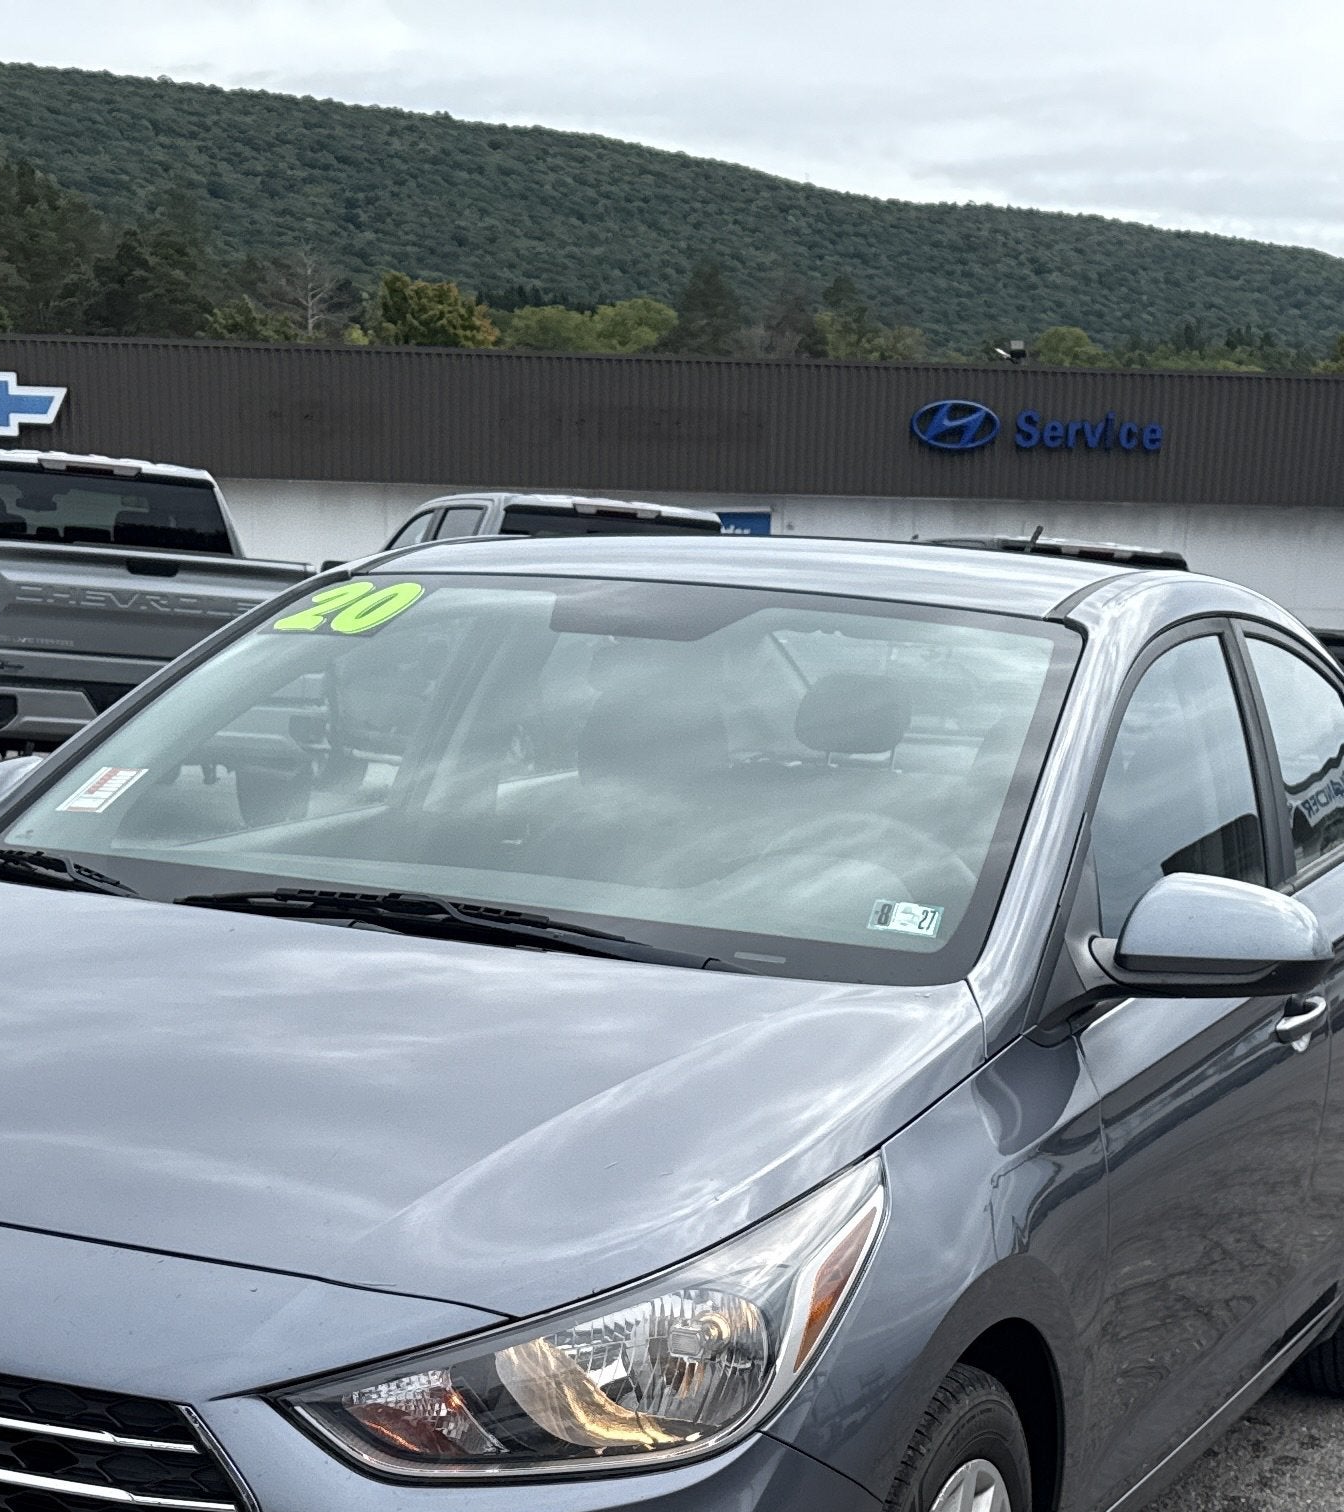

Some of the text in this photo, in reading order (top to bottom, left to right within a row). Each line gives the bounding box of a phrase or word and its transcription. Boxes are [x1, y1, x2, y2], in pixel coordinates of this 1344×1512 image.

[1014, 409, 1164, 449] Service
[15, 582, 266, 617] CHEVROLE
[273, 581, 425, 634] 20
[918, 909, 937, 930] 27
